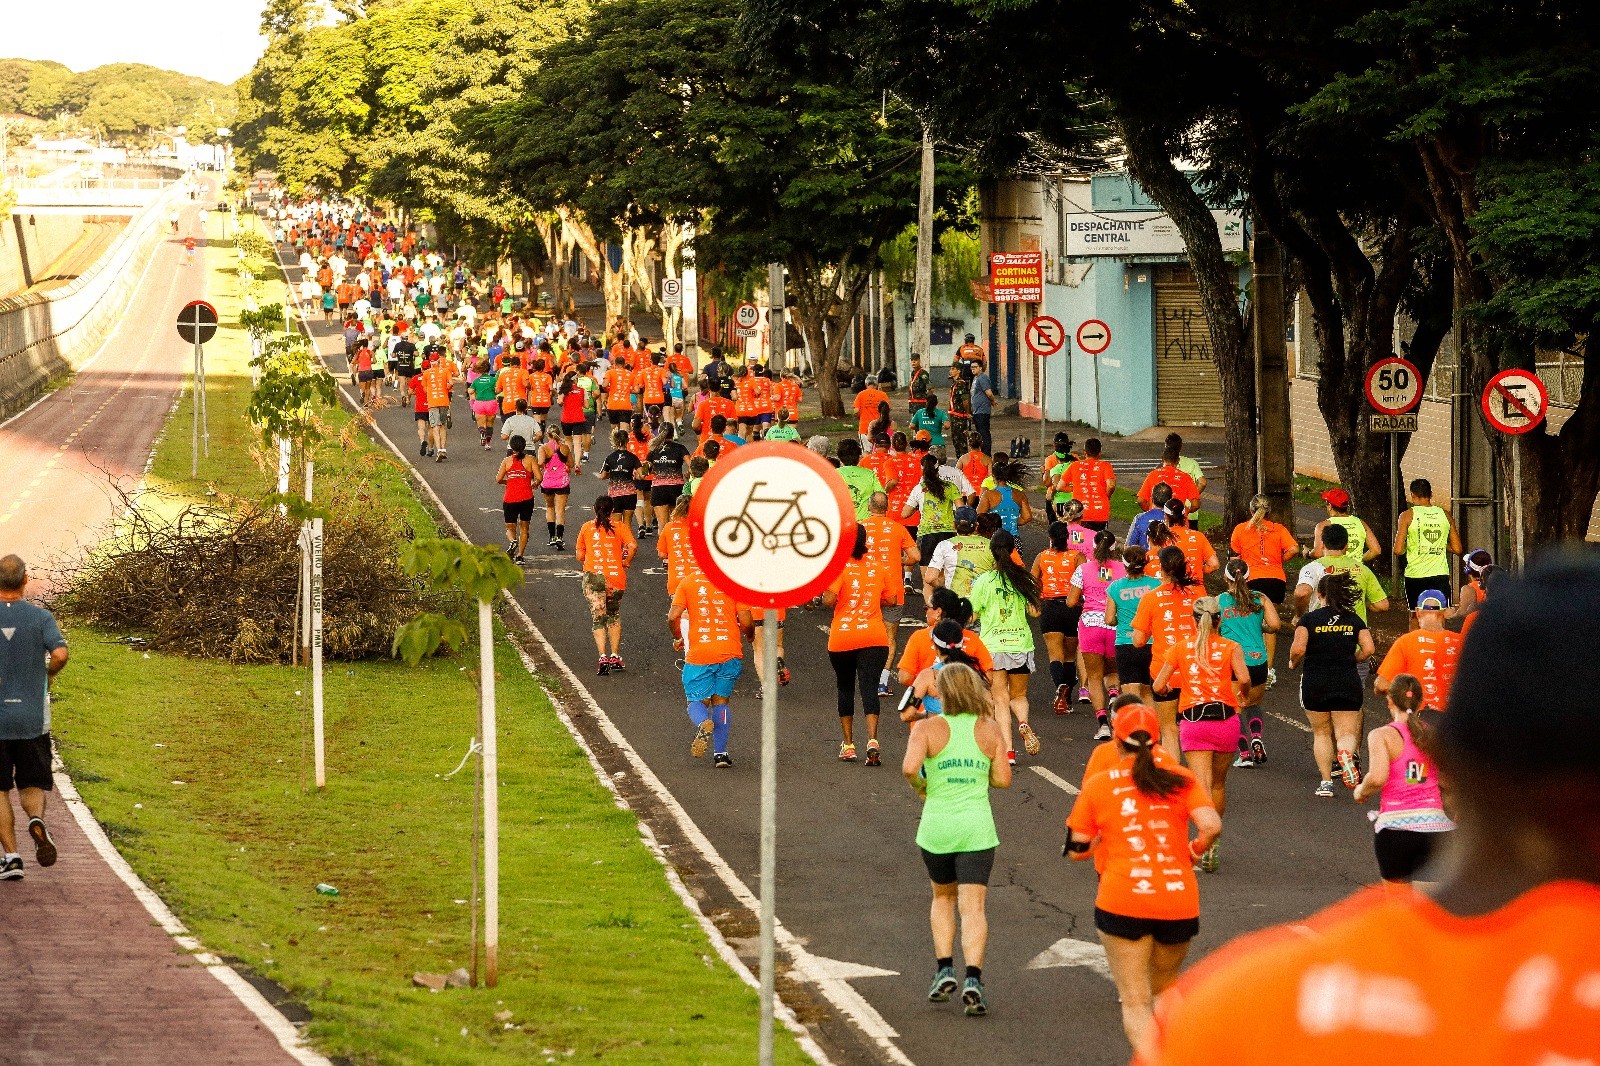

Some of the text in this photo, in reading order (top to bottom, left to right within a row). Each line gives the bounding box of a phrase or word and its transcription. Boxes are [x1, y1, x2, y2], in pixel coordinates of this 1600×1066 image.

[1070, 221, 1145, 232] DESPACHANTE
[1084, 233, 1130, 243] CENTRAL
[996, 267, 1038, 276] CORTINAS
[994, 276, 1040, 286] PERSIANAS
[668, 282, 676, 293] E
[740, 308, 755, 318] 50
[737, 328, 756, 337] RADAR
[1378, 368, 1409, 391] 50
[1373, 416, 1415, 430] RADAR
[313, 535, 323, 648] VIVEIRO SEMUSP PMM
[1314, 624, 1354, 633] eucorro
[938, 758, 962, 771] CORRA
[964, 759, 974, 768] NA
